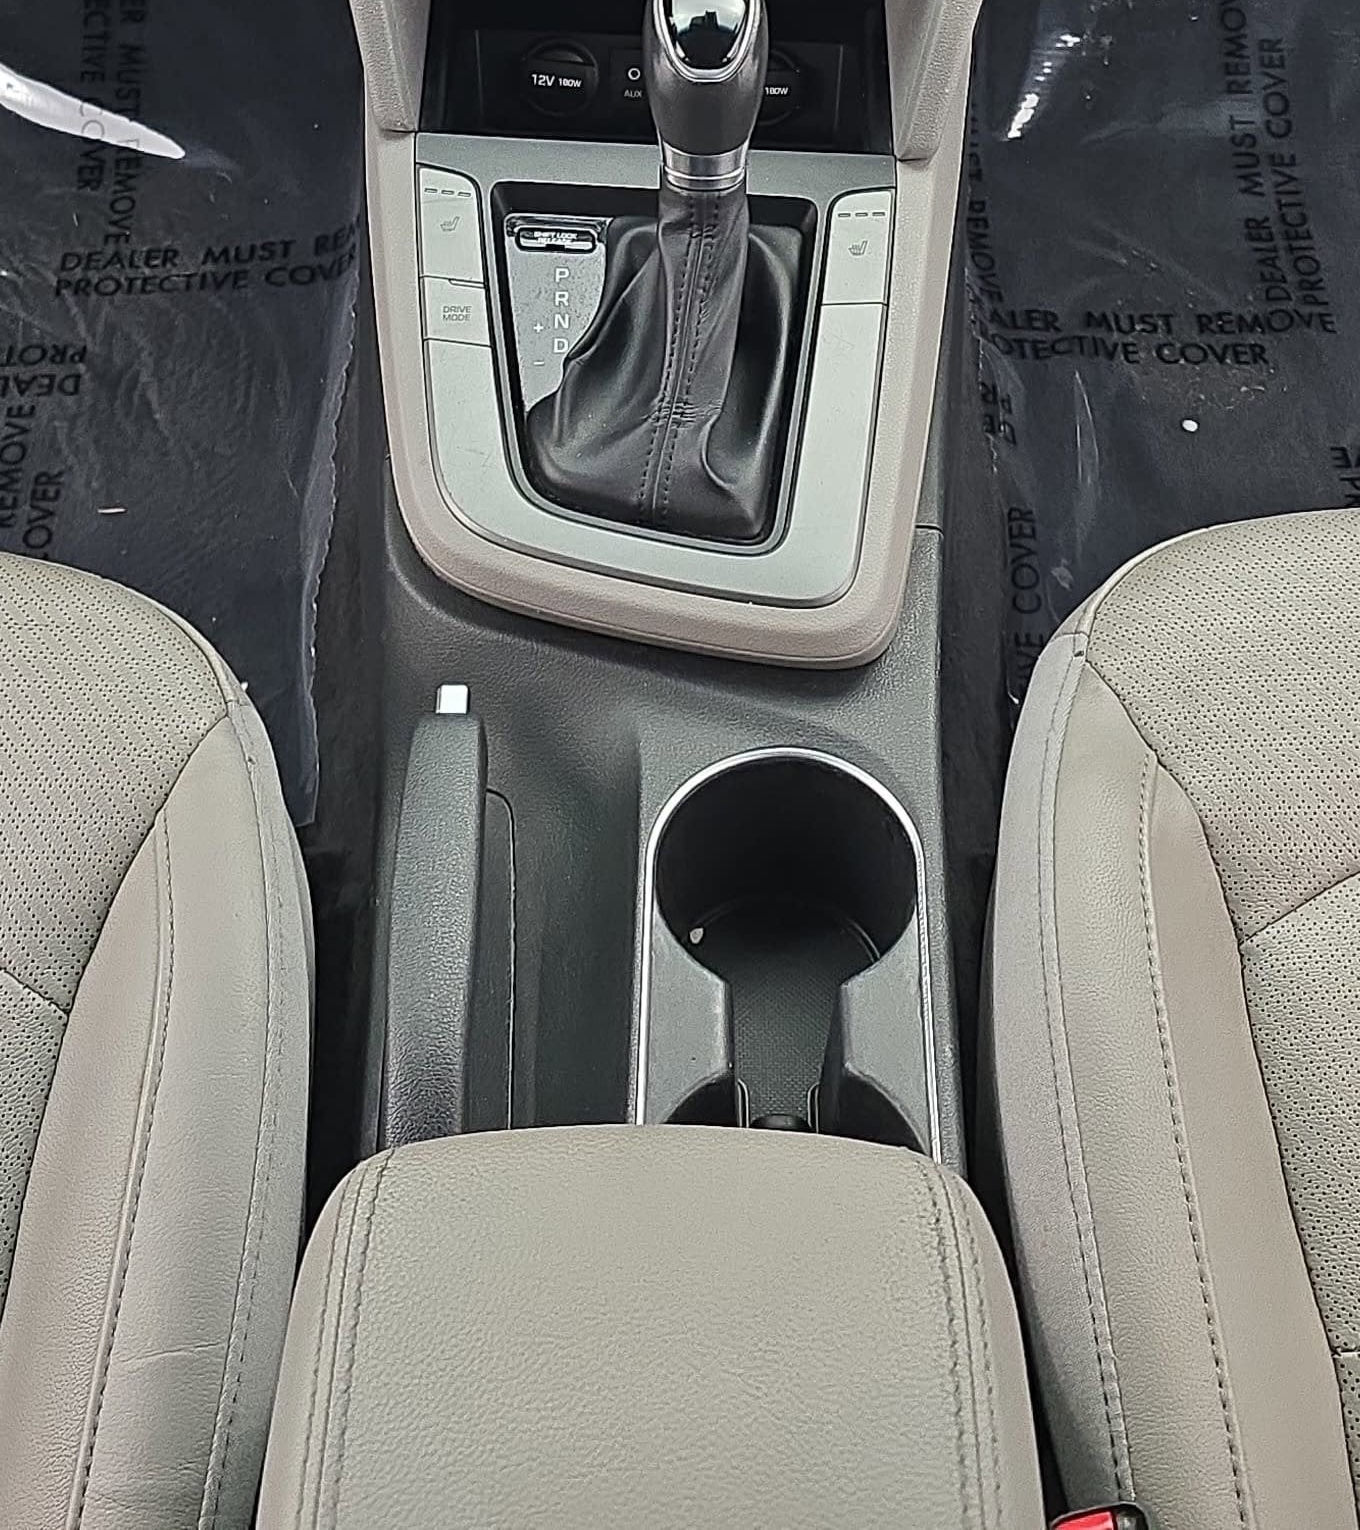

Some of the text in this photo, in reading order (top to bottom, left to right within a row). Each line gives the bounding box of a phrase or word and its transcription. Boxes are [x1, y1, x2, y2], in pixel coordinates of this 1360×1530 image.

[531, 74, 582, 88] 12V 180W
[1229, 115, 1267, 197] MUST
[1258, 37, 1330, 306] PROTECTIVE COVER
[60, 239, 297, 272] DEALER MUST
[1244, 216, 1292, 302] DEALER
[55, 270, 249, 298] PROTECTIVE
[555, 268, 569, 283] P
[443, 305, 472, 314] DRIVE
[555, 292, 569, 306] R
[442, 313, 472, 322] MODE
[554, 314, 568, 328] N
[1086, 312, 1174, 335] MUST
[1197, 308, 1338, 336] REMOVE
[554, 338, 568, 353] D
[1156, 342, 1268, 366] COVER
[22, 467, 64, 558] OVER
[1007, 504, 1042, 615] COVER
